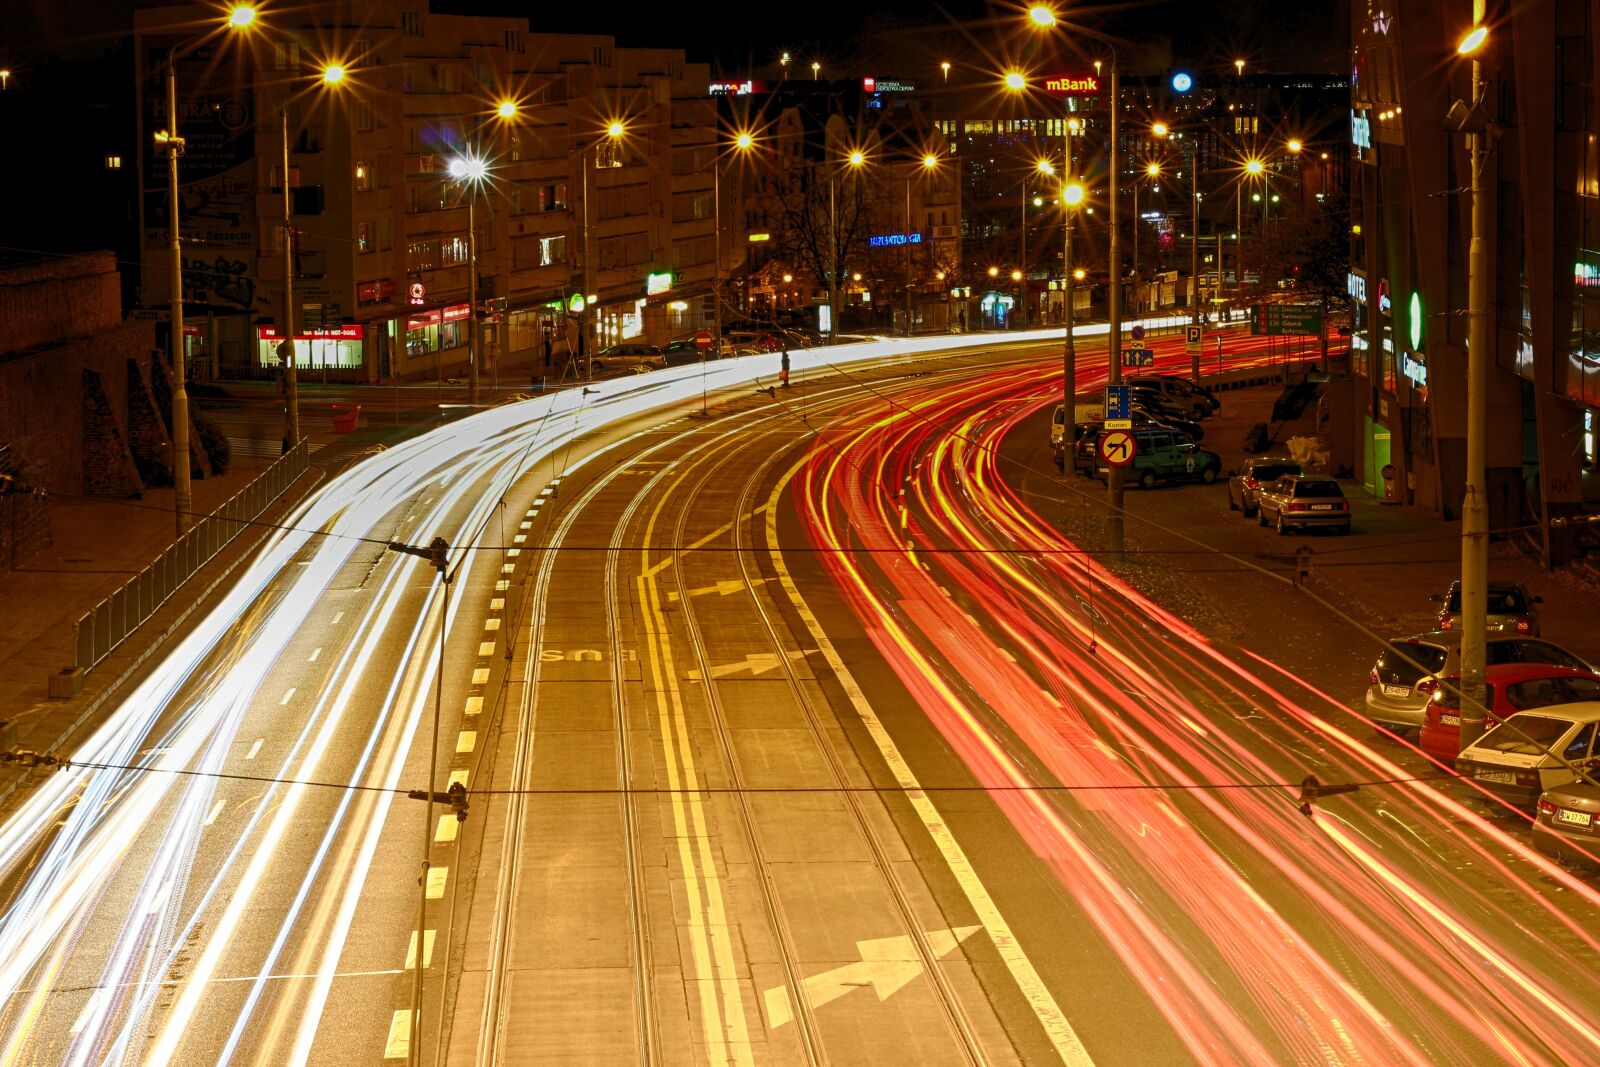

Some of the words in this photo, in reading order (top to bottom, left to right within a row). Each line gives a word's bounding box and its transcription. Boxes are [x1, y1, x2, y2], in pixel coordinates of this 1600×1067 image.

[1046, 77, 1097, 90] mBank
[207, 231, 251, 240] Szczecin
[1190, 330, 1198, 341] P
